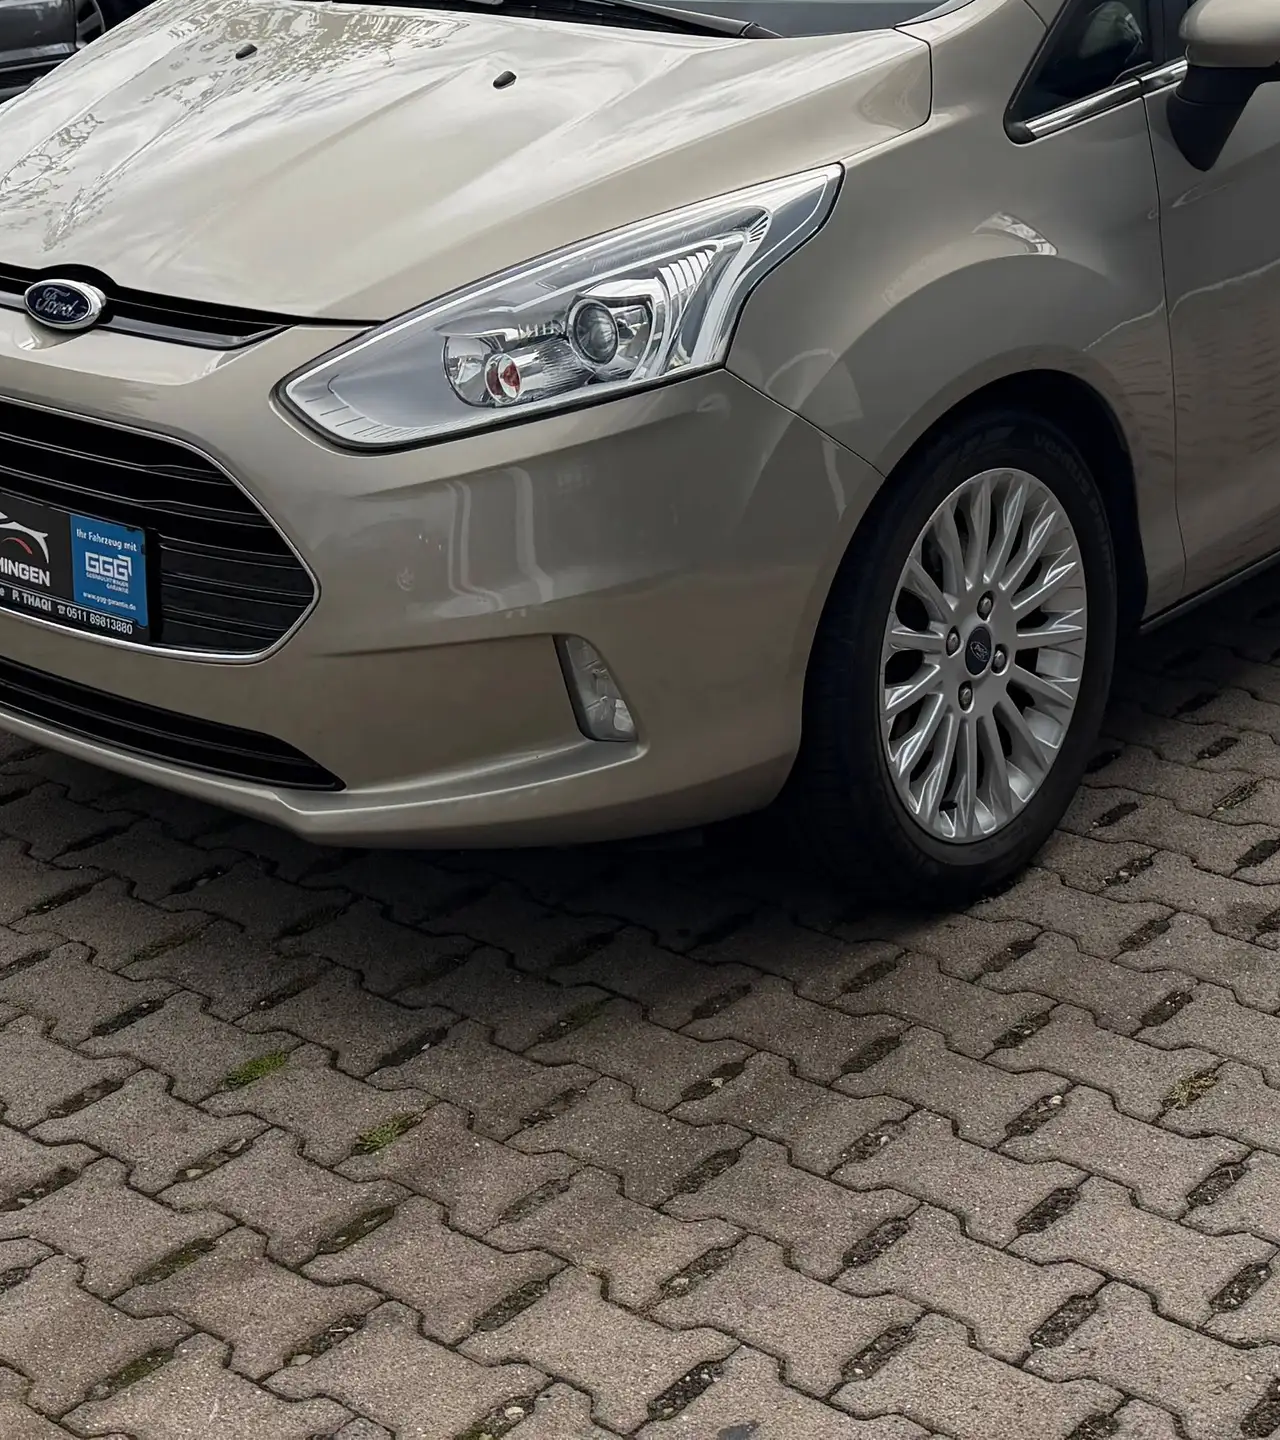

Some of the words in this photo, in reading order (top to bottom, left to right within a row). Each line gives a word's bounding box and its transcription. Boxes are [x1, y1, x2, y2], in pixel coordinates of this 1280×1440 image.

[36, 287, 80, 317] Ford
[76, 528, 87, 539] Ihr
[88, 531, 122, 550] Fahrzeug
[123, 541, 138, 552] mit
[85, 551, 132, 581] GGG
[22, 592, 52, 612] THAQI
[66, 604, 87, 623] 0511
